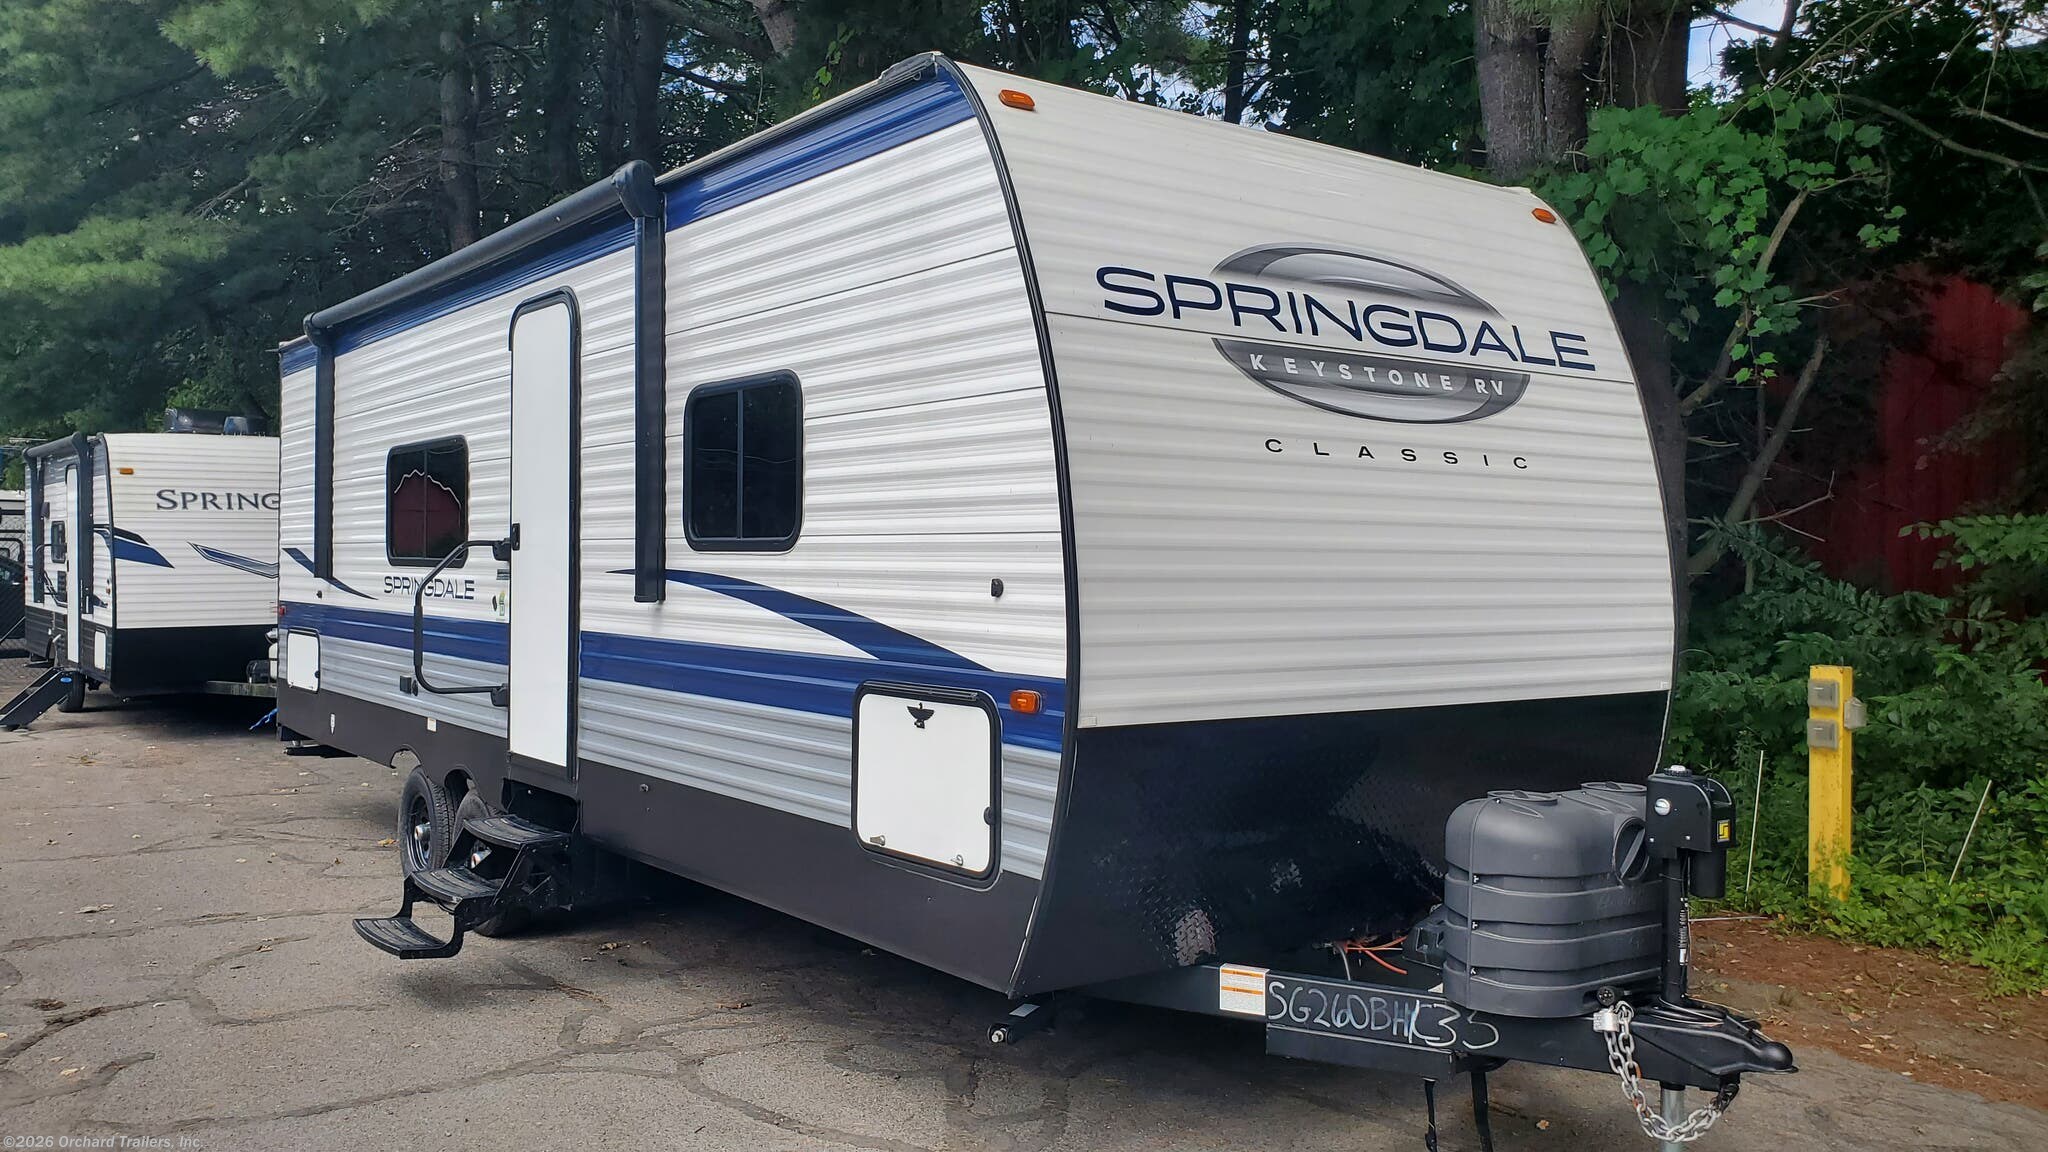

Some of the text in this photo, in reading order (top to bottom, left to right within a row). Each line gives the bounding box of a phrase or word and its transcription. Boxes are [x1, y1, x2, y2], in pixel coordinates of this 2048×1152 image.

[1096, 266, 1596, 371] SPRINGDALE
[1249, 353, 1504, 396] KEYSTONE RV
[1264, 438, 1528, 469] CLASSIC
